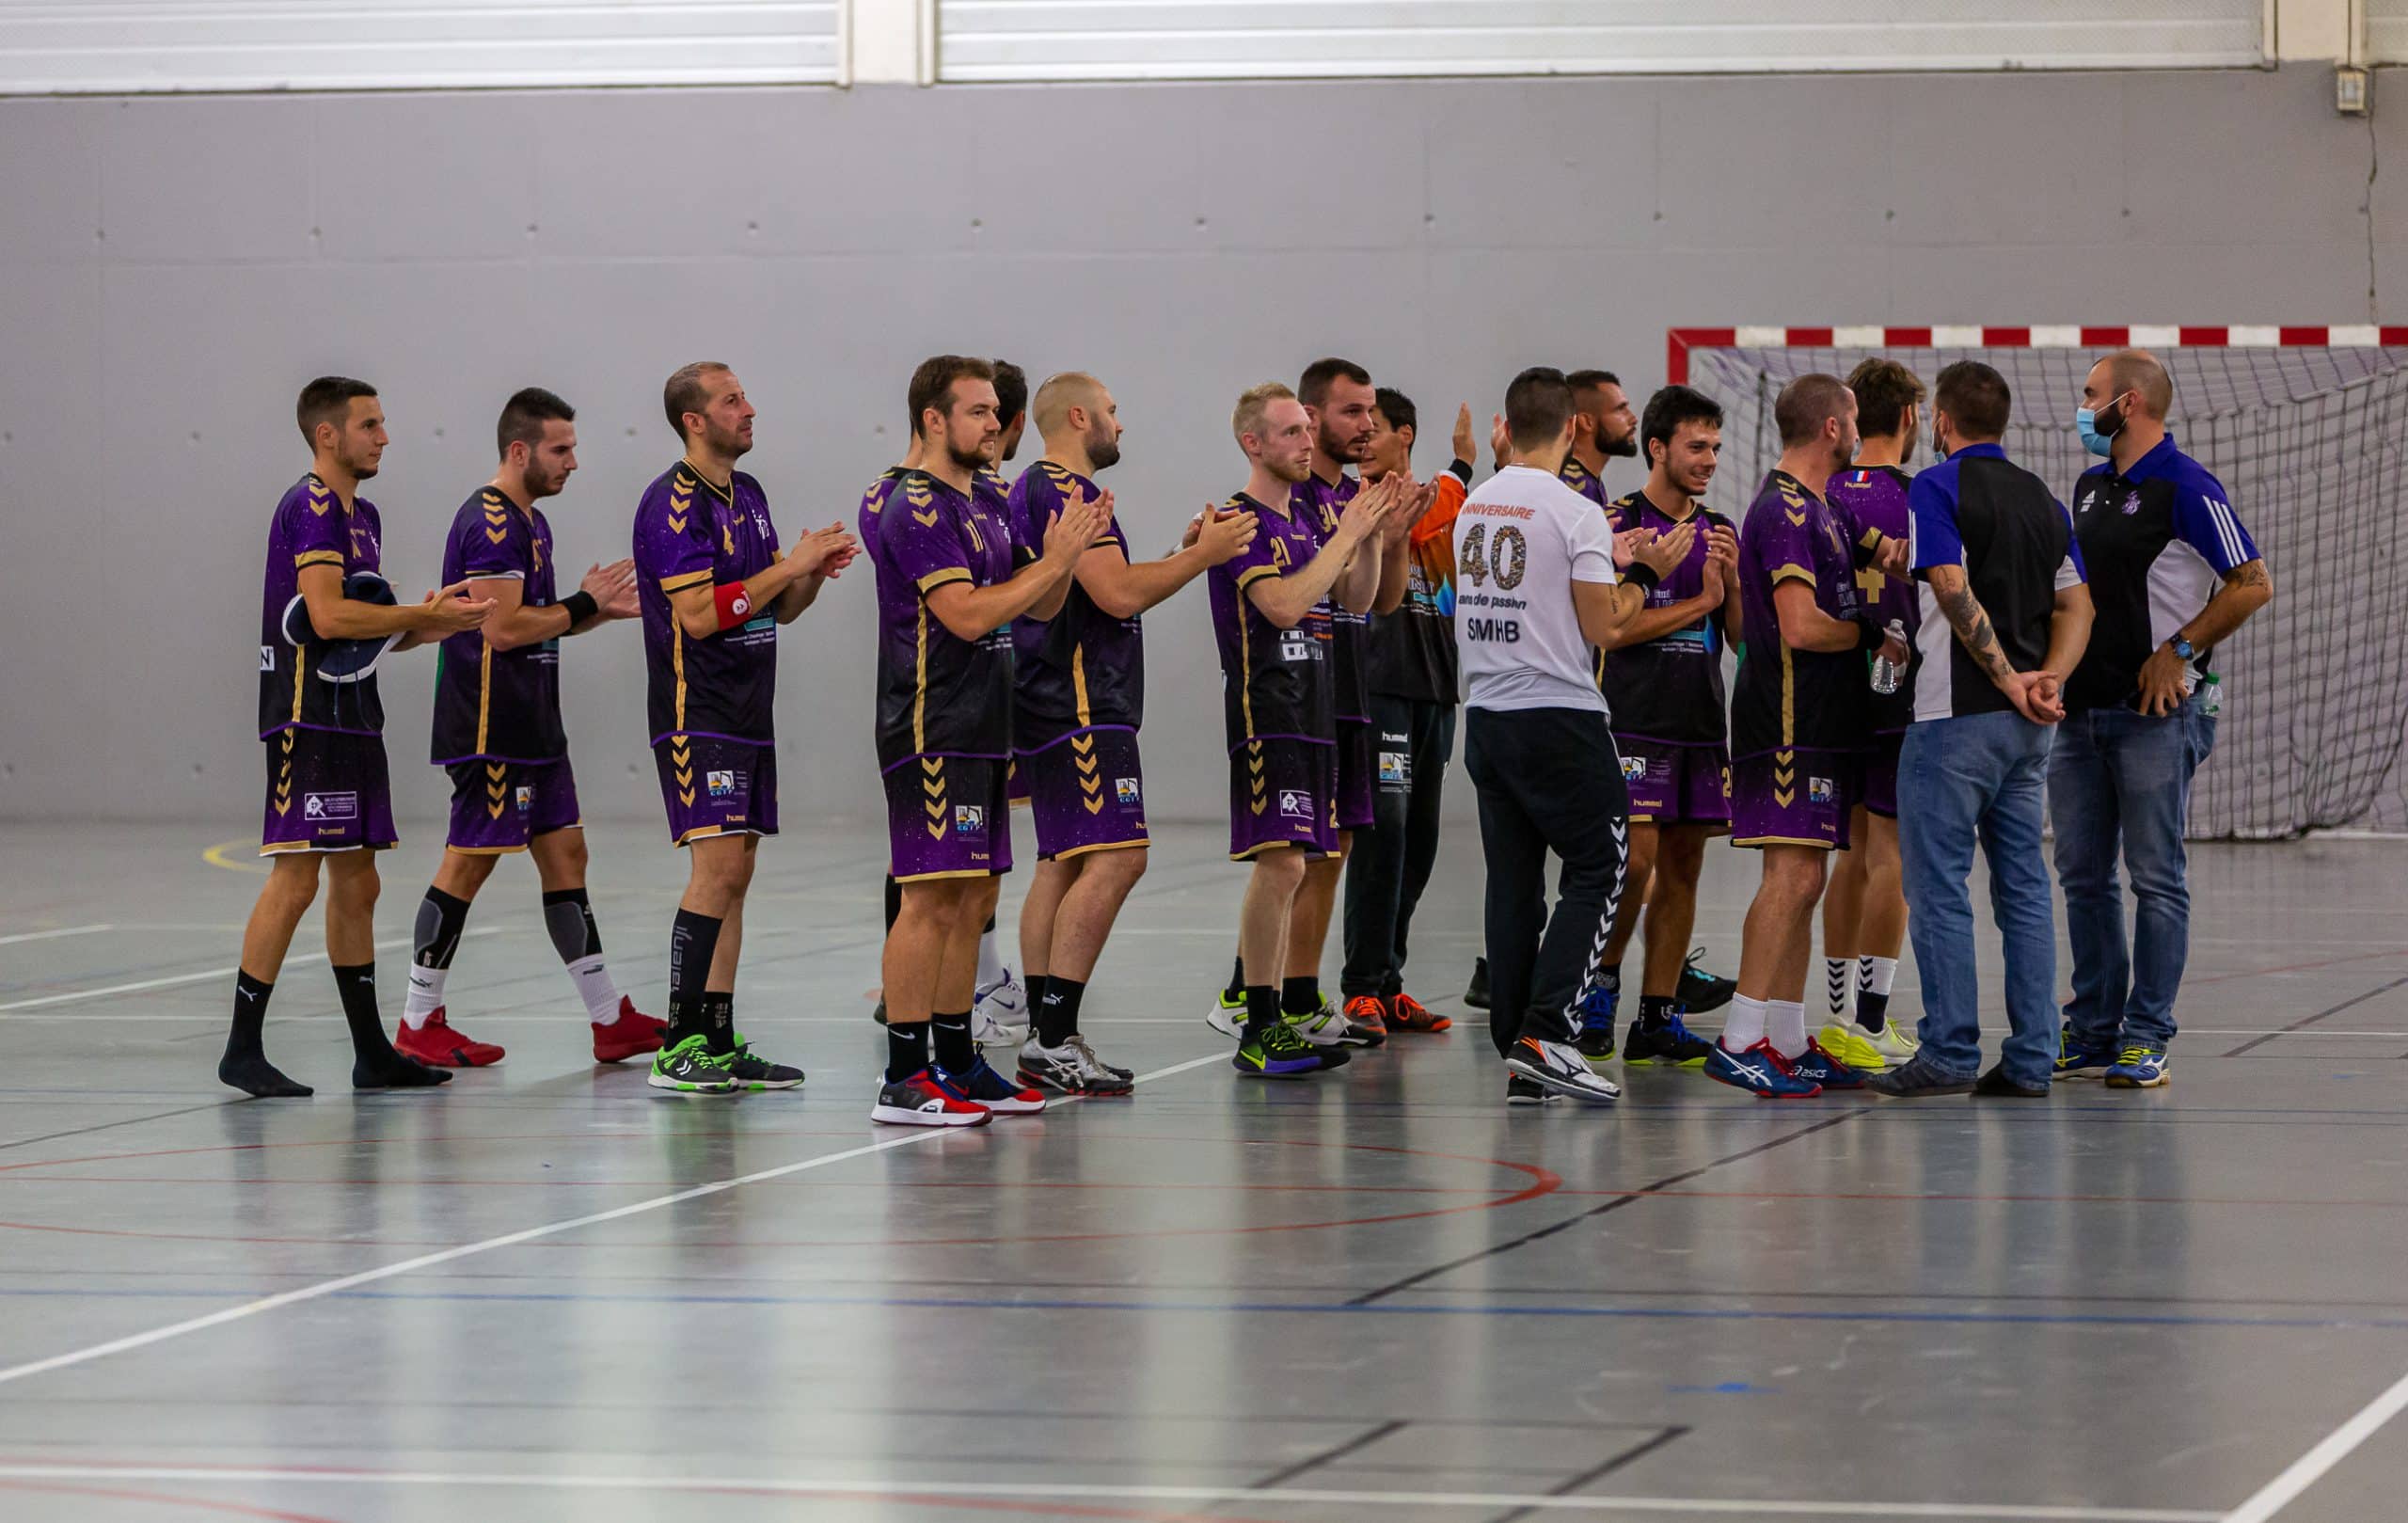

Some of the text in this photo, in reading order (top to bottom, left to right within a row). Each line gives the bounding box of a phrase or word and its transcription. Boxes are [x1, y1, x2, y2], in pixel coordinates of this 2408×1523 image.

[1270, 536, 1292, 567] 21
[1460, 523, 1527, 591] 40
[1467, 617, 1520, 643] SMHB
[1633, 799, 1663, 808] hummel
